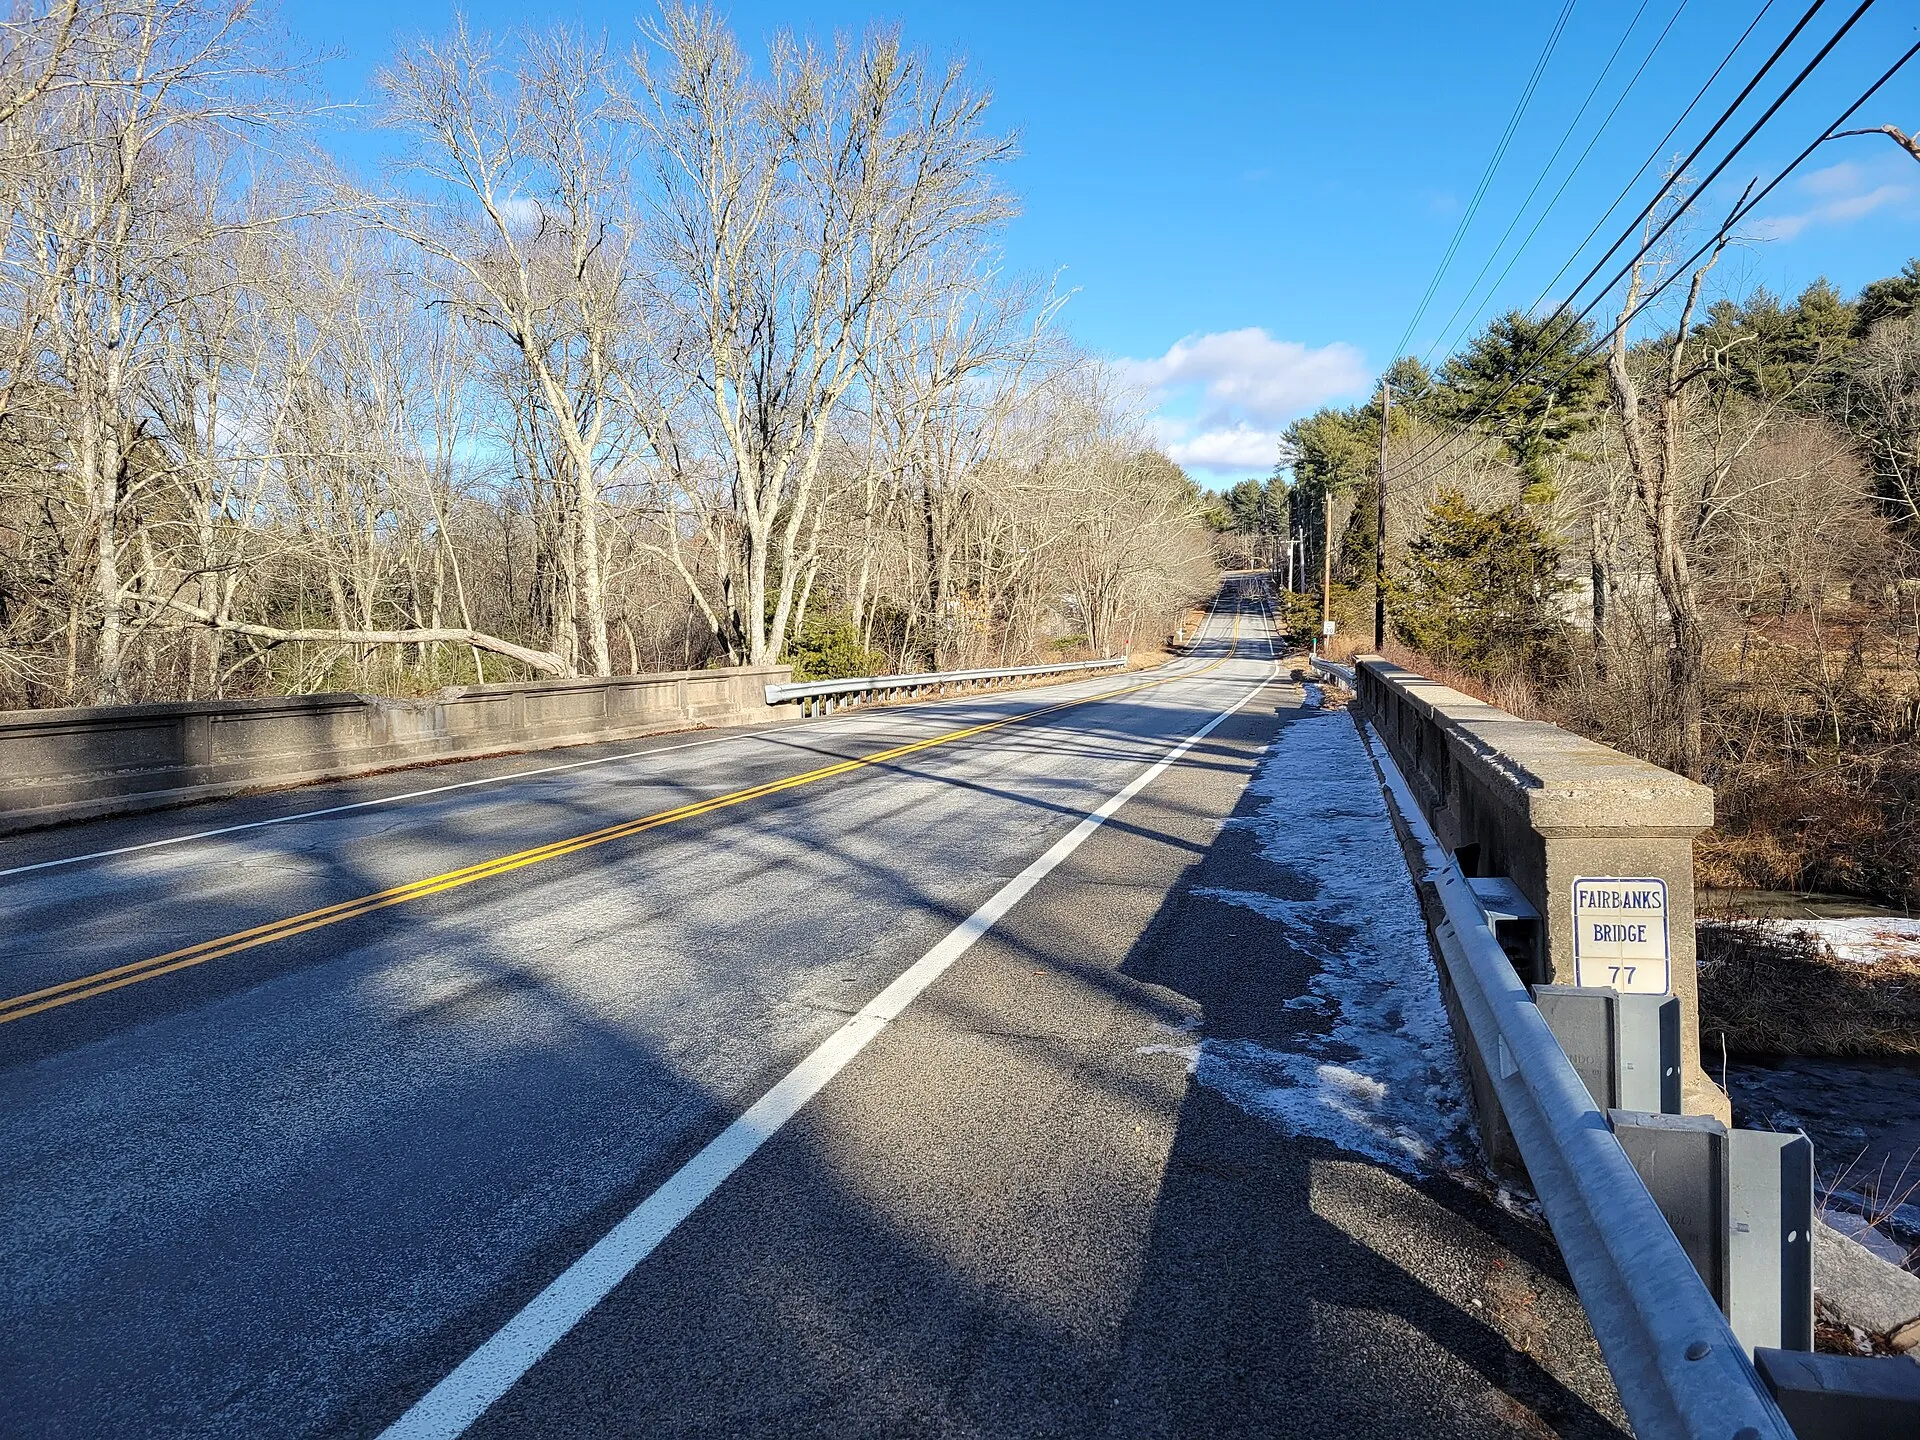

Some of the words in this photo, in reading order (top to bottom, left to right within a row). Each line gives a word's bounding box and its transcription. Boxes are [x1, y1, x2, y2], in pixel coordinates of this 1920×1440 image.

[1579, 890, 1661, 909] FAIRBANKS
[1593, 924, 1647, 942] BRIDGE
[1608, 966, 1636, 984] 77
